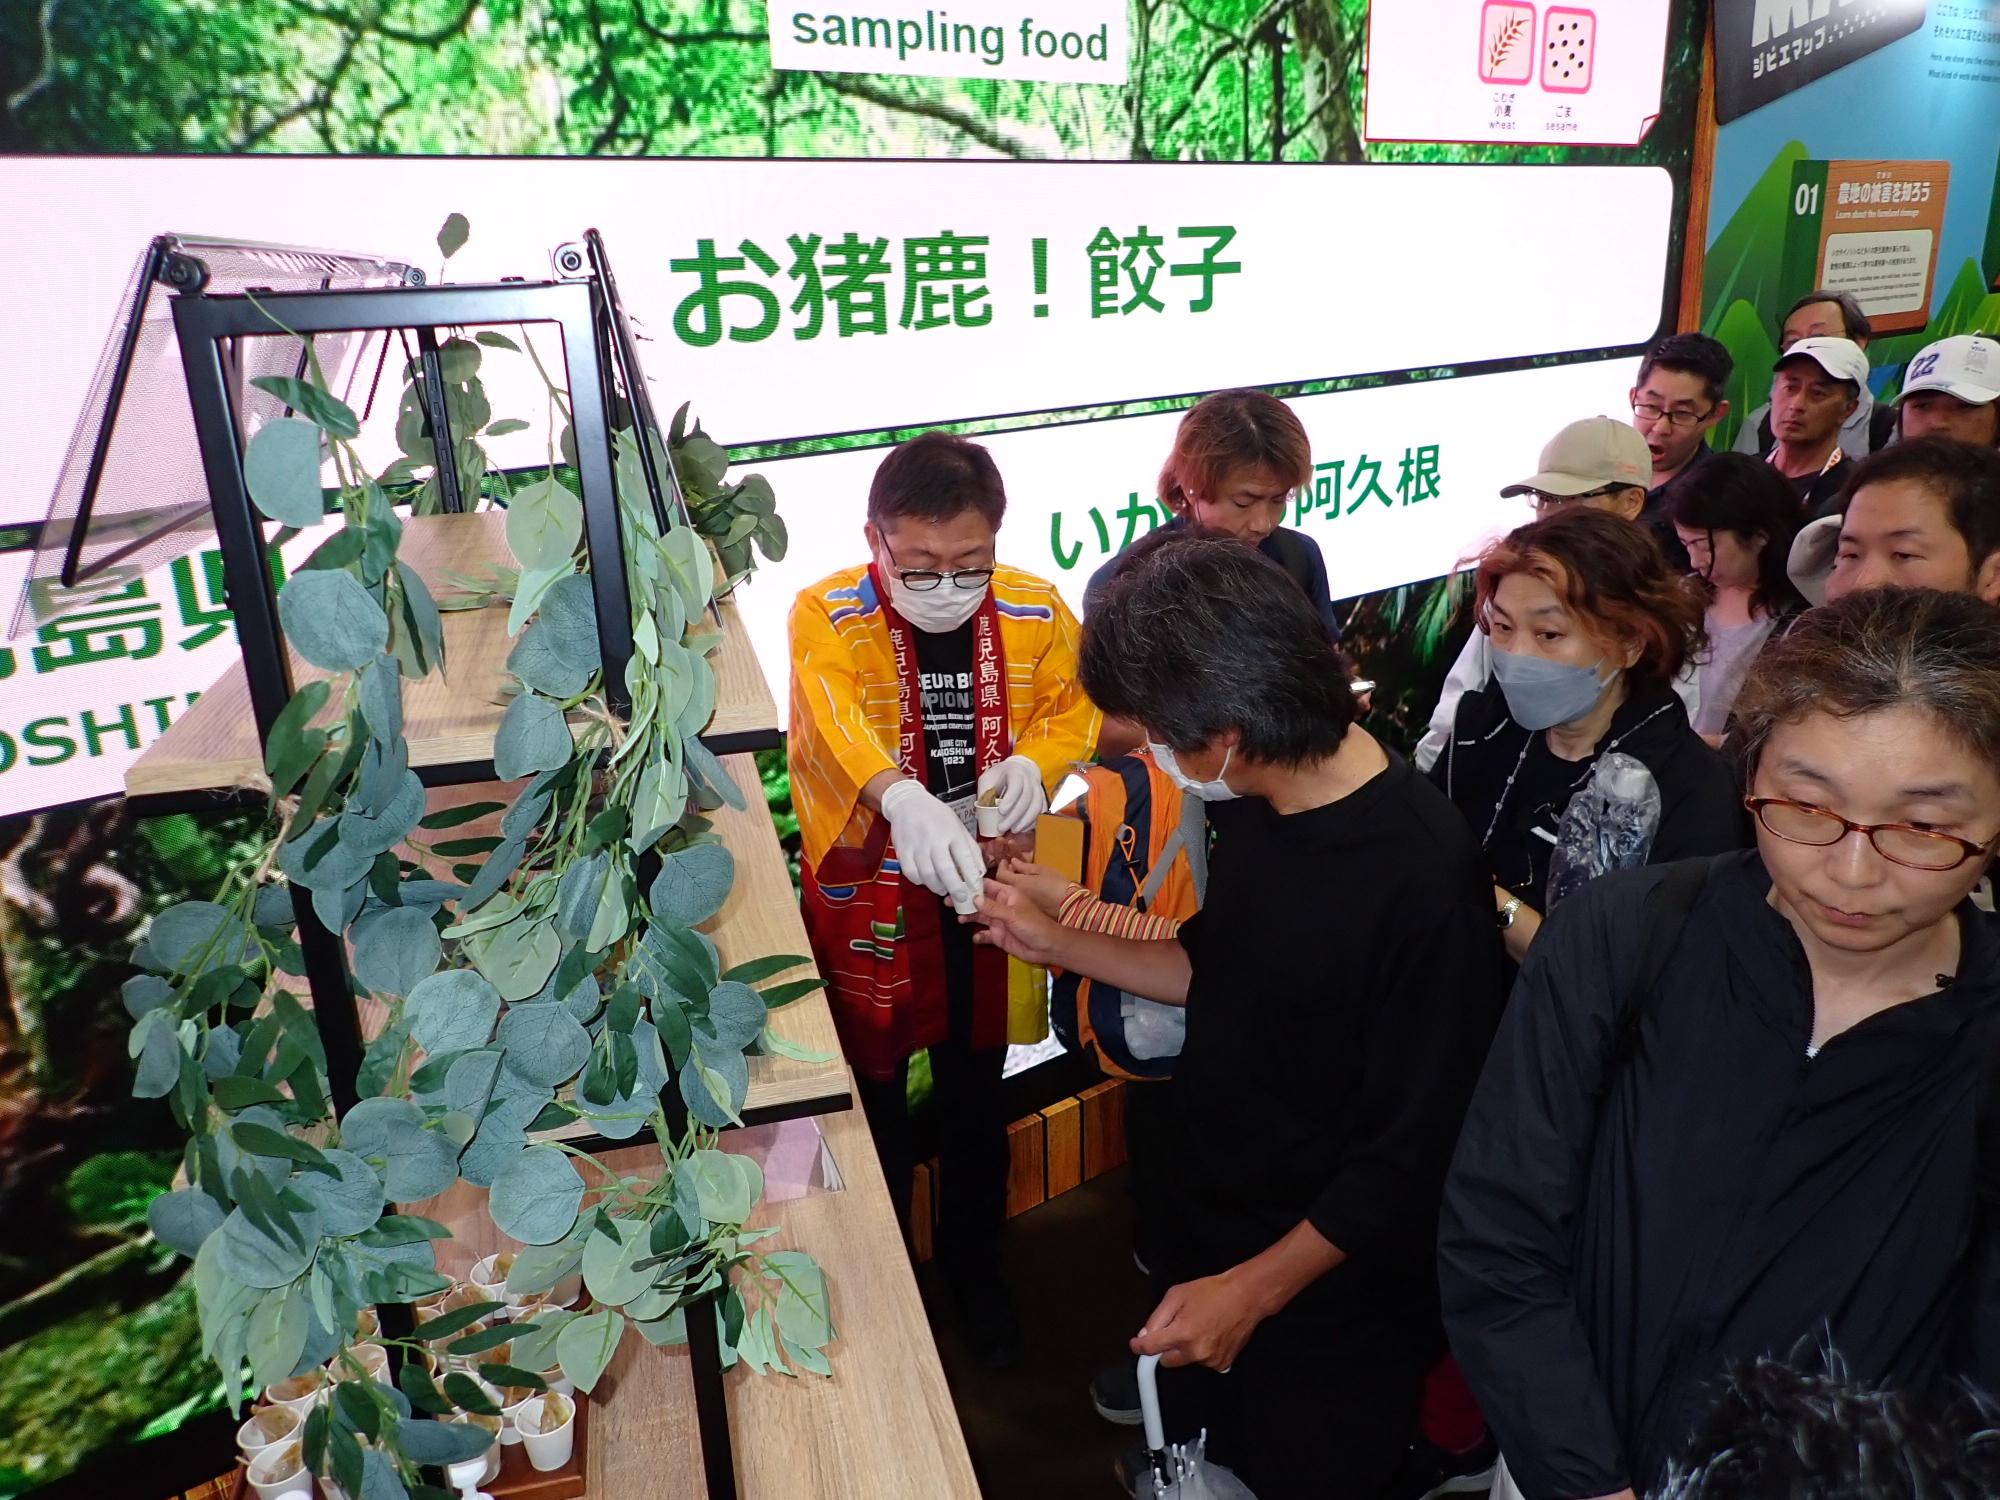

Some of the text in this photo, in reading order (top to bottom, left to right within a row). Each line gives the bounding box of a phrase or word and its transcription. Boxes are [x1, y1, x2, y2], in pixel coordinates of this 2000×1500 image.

[792, 10, 1107, 65] sampling food
[1494, 104, 1511, 117] 小麦
[1555, 105, 1572, 118] ごま
[1489, 121, 1516, 130] wheat
[1545, 122, 1577, 131] sesame
[1795, 183, 1819, 215] 01
[669, 224, 1242, 348] お猪鹿！餃子
[978, 614, 1001, 708] 鹿児島県
[956, 672, 973, 689] B
[942, 756, 965, 766] 2023
